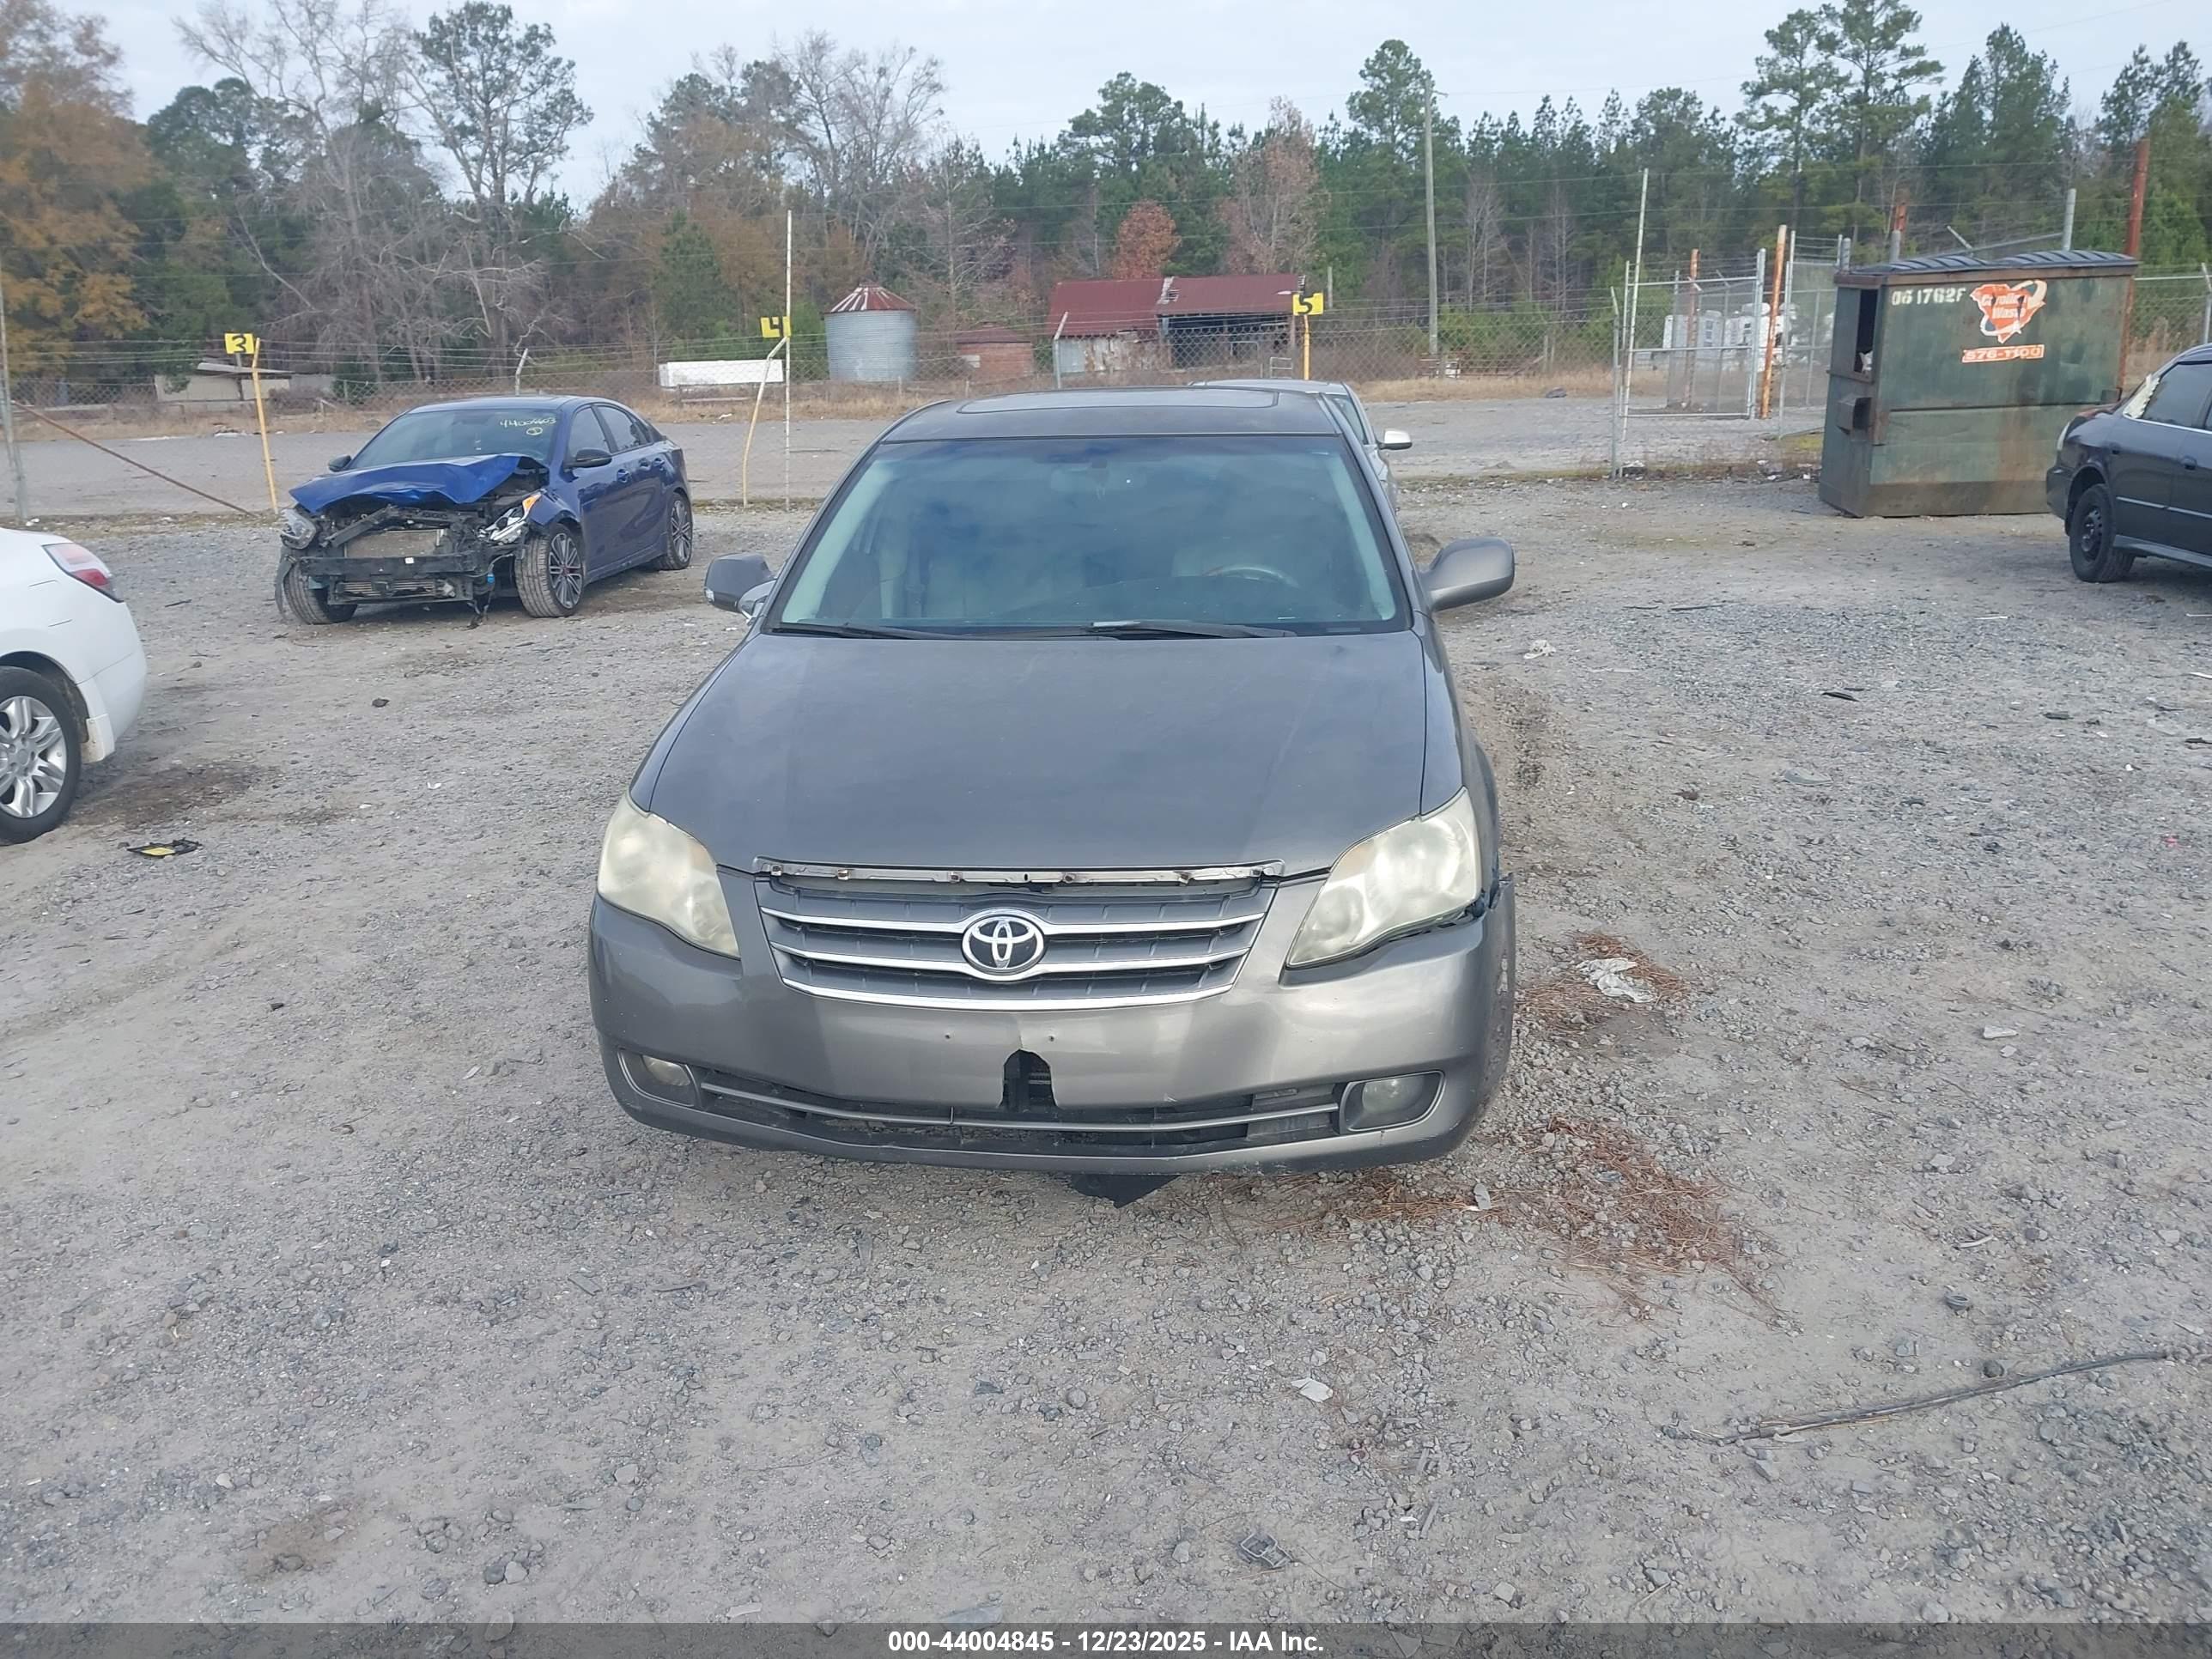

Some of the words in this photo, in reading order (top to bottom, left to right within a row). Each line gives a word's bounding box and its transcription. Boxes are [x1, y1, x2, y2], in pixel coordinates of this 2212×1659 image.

[1298, 292, 1314, 315] 5
[769, 315, 784, 337] 4
[232, 334, 247, 353] 3
